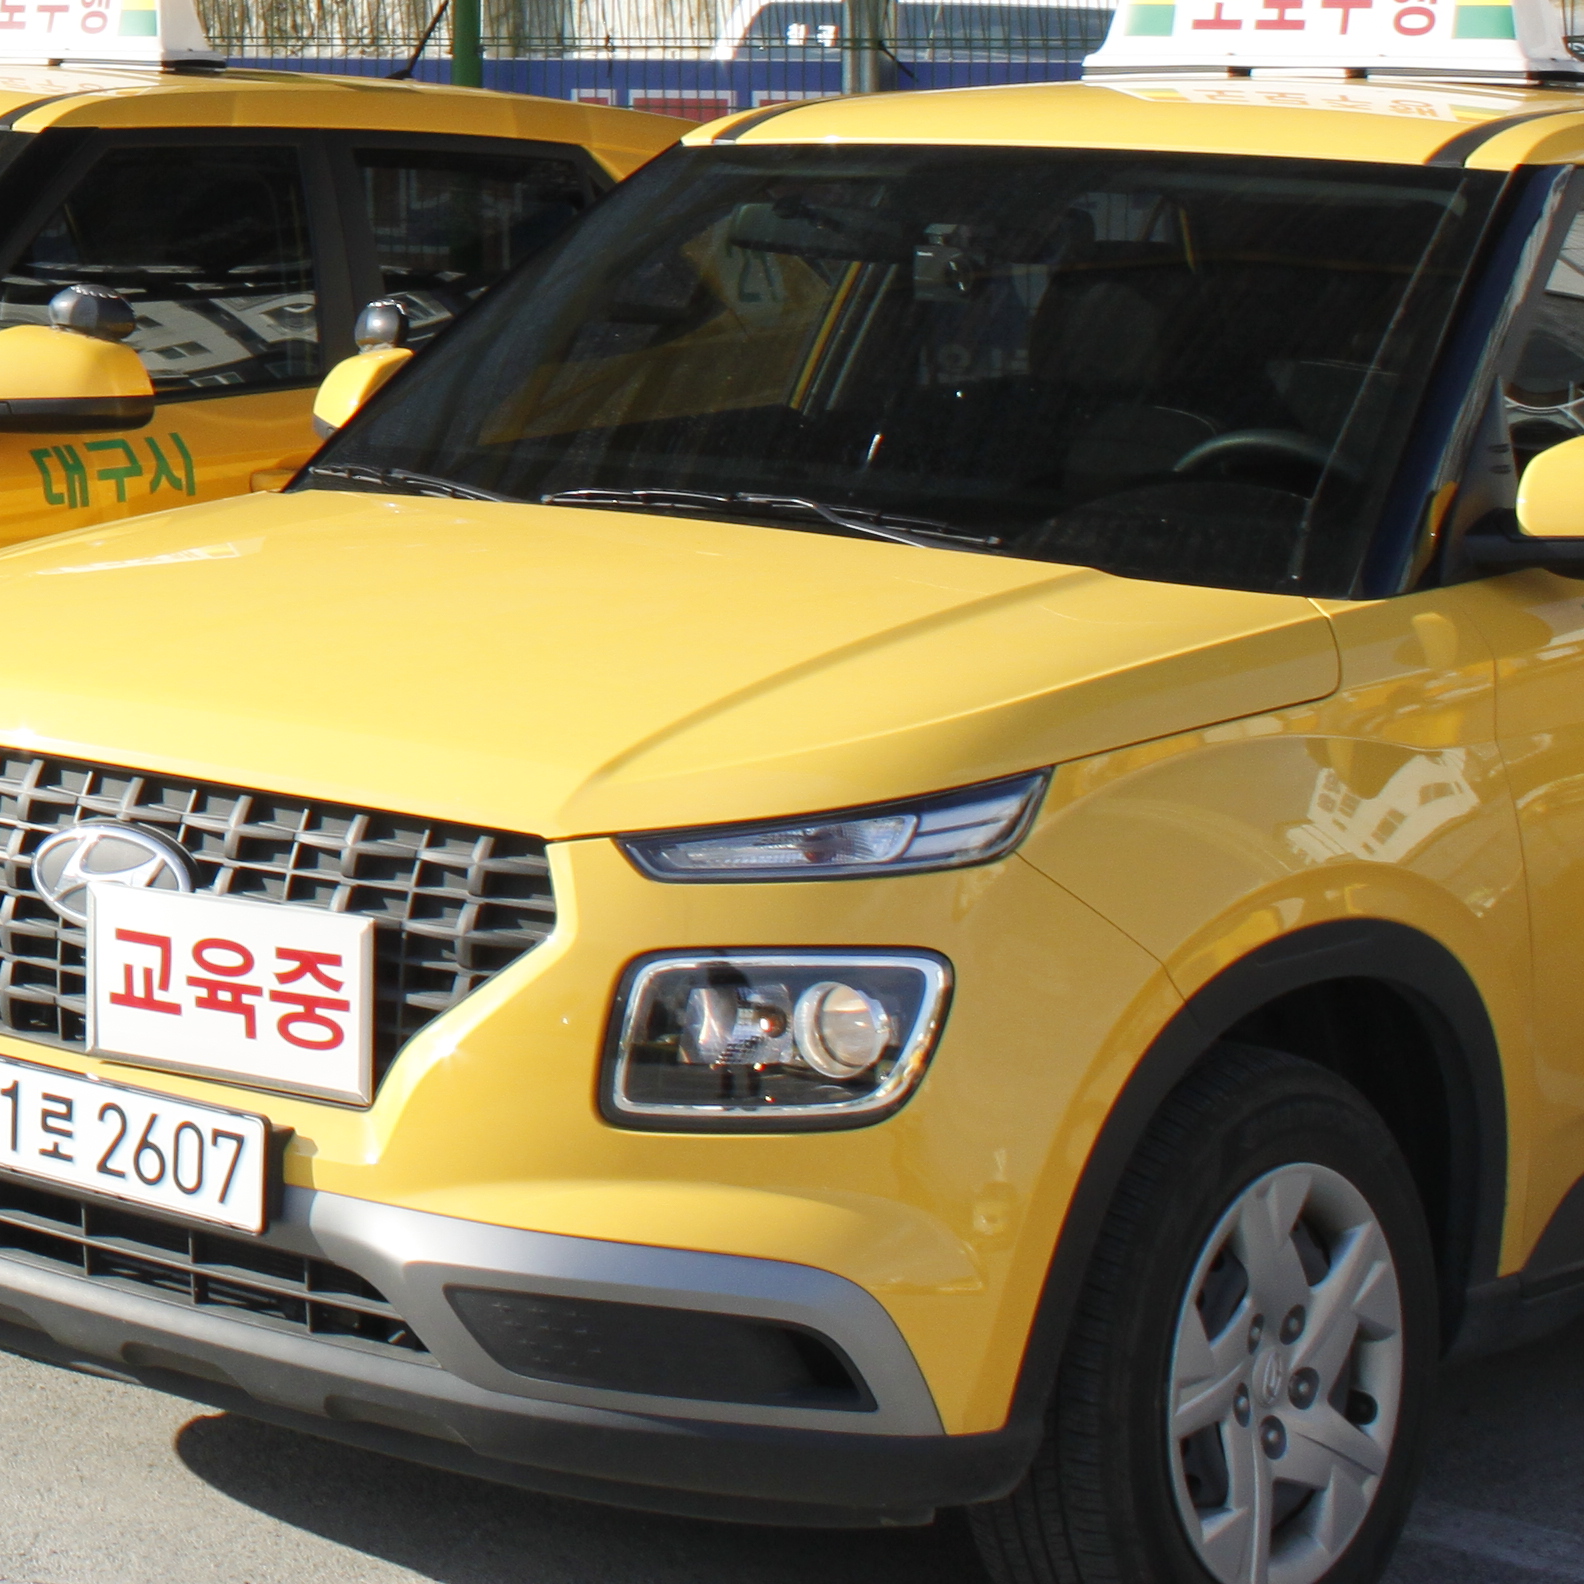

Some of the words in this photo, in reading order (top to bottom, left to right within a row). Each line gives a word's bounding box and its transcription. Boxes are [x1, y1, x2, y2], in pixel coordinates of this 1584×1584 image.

[28, 431, 196, 509] 대구시
[108, 927, 351, 1051] 교육중
[96, 1102, 246, 1205] 2607
